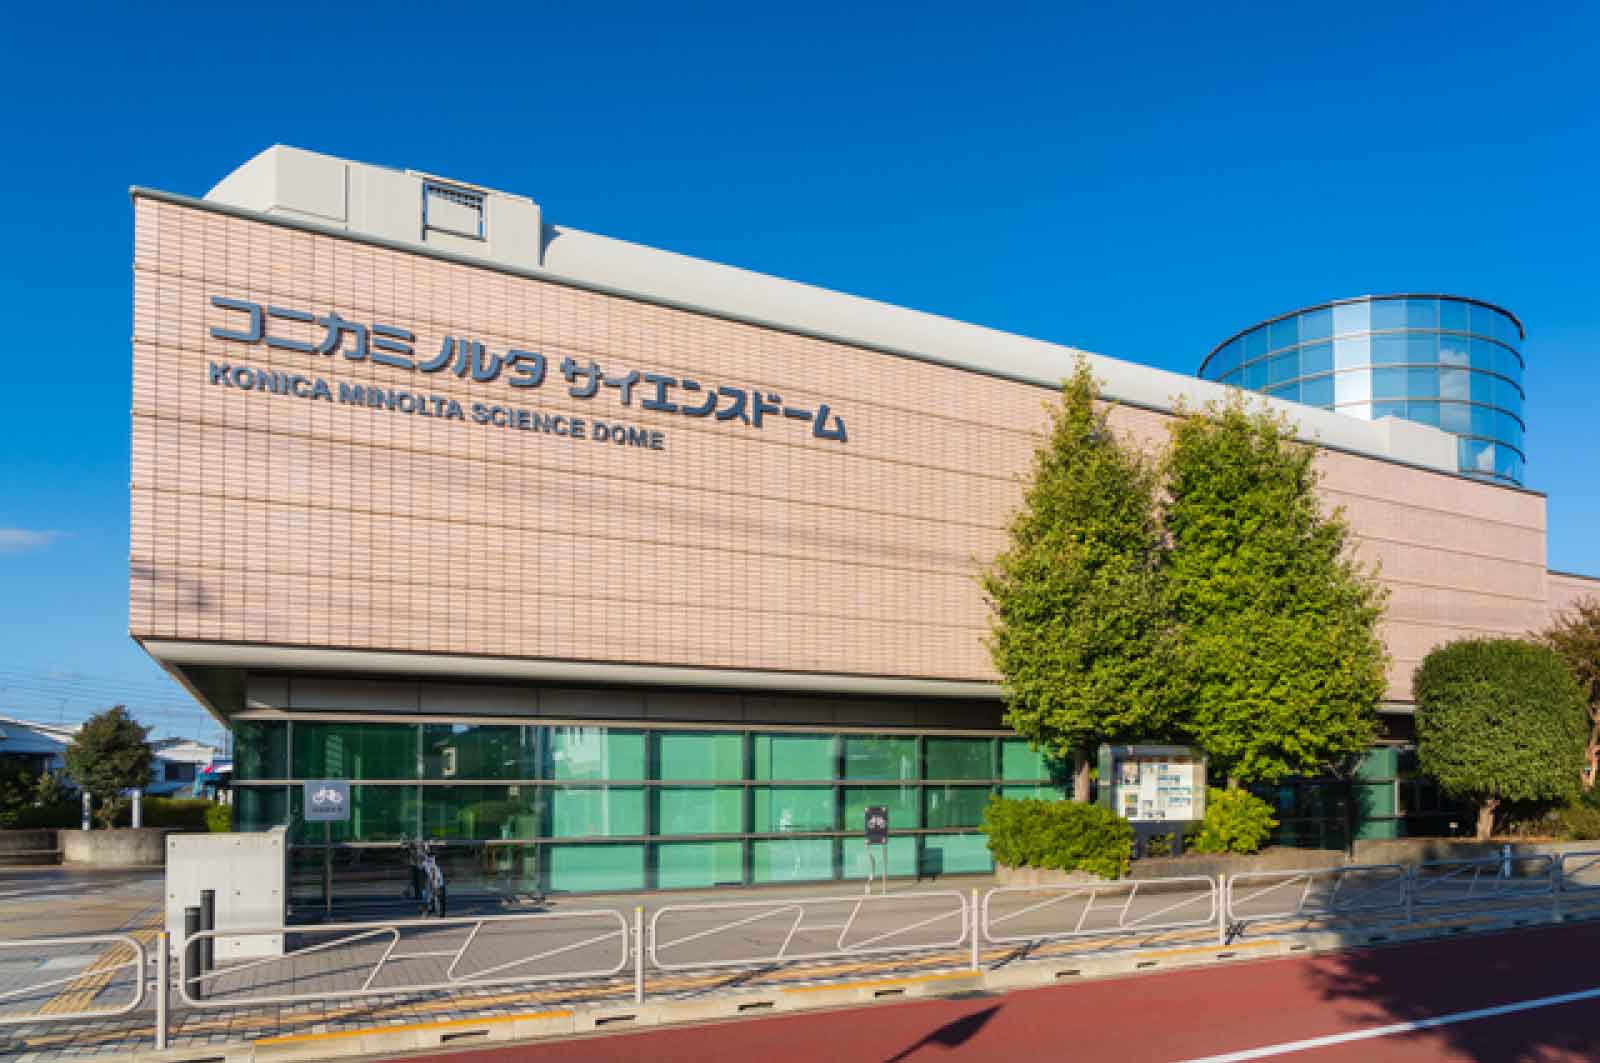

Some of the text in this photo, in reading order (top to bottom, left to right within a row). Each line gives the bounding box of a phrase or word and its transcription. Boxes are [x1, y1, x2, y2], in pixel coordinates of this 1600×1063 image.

[209, 362, 665, 450] KONICA MINOLTA SCIENCE DOME
[210, 296, 848, 442] コニカミノルタ サイエンスドーム
